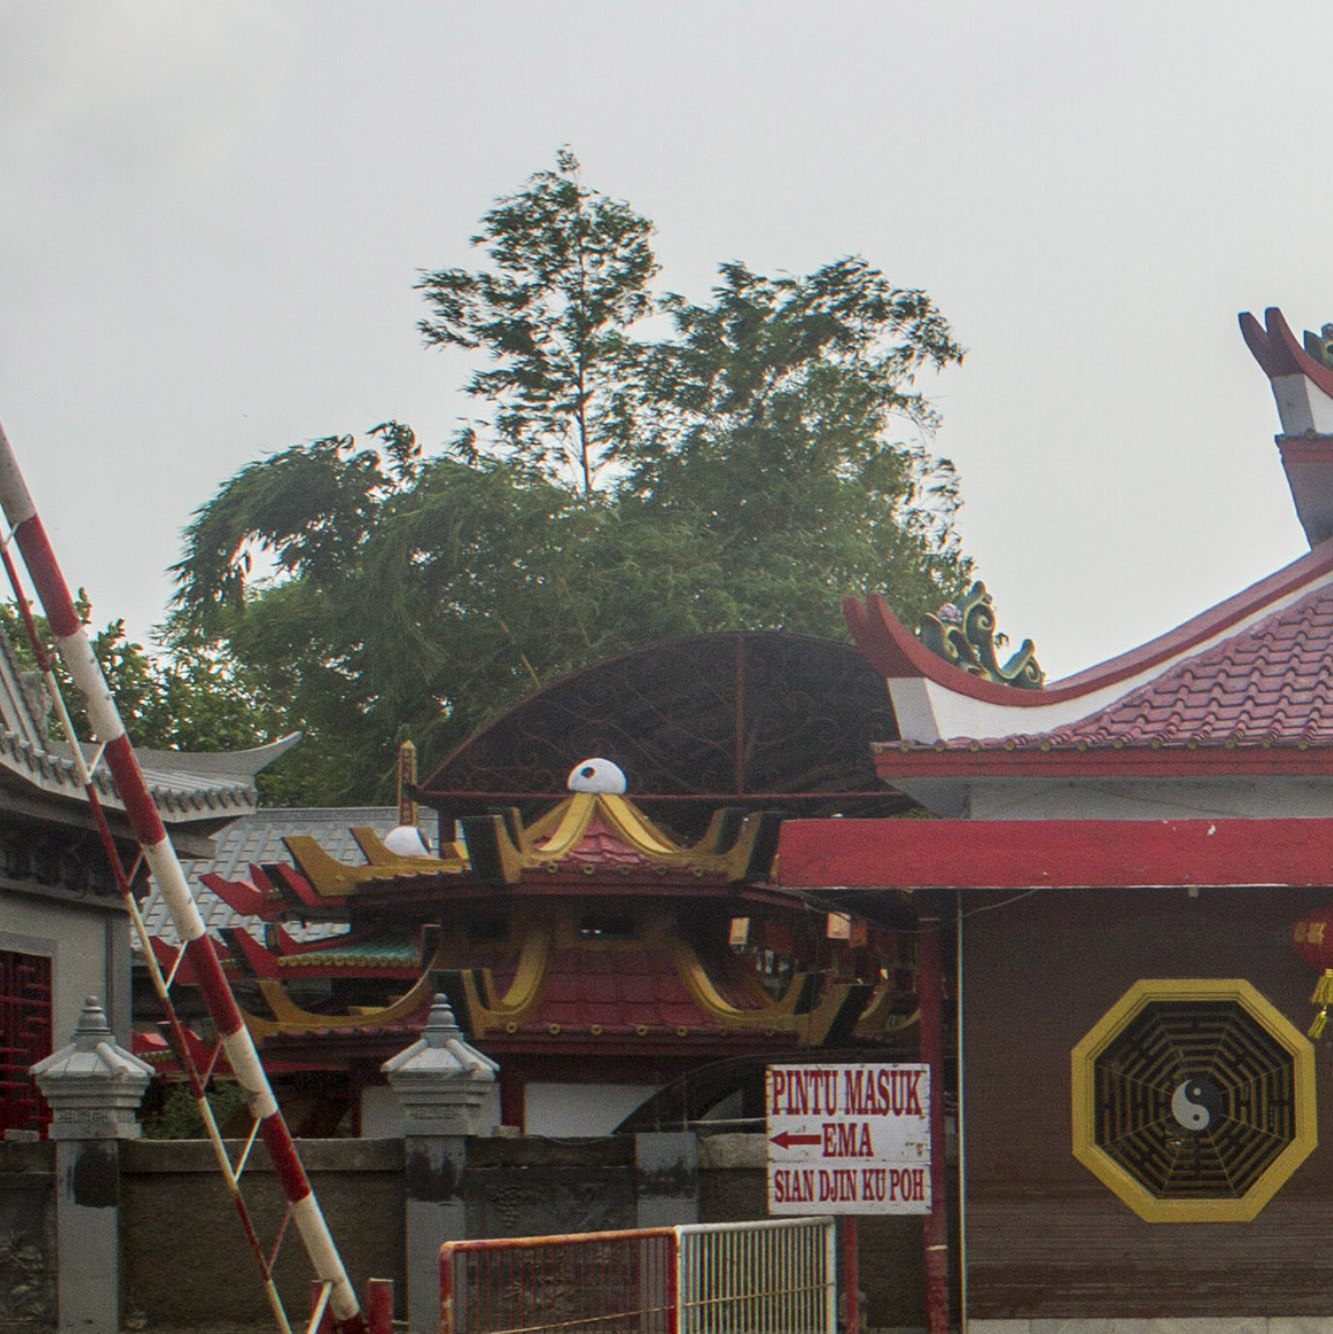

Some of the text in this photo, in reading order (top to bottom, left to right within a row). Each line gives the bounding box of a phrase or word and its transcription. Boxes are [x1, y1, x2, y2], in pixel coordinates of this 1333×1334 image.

[771, 1069, 922, 1117] PINTU MASUK
[822, 1122, 874, 1157] EMA
[774, 1169, 925, 1203] SIAN DJIN KU POH
